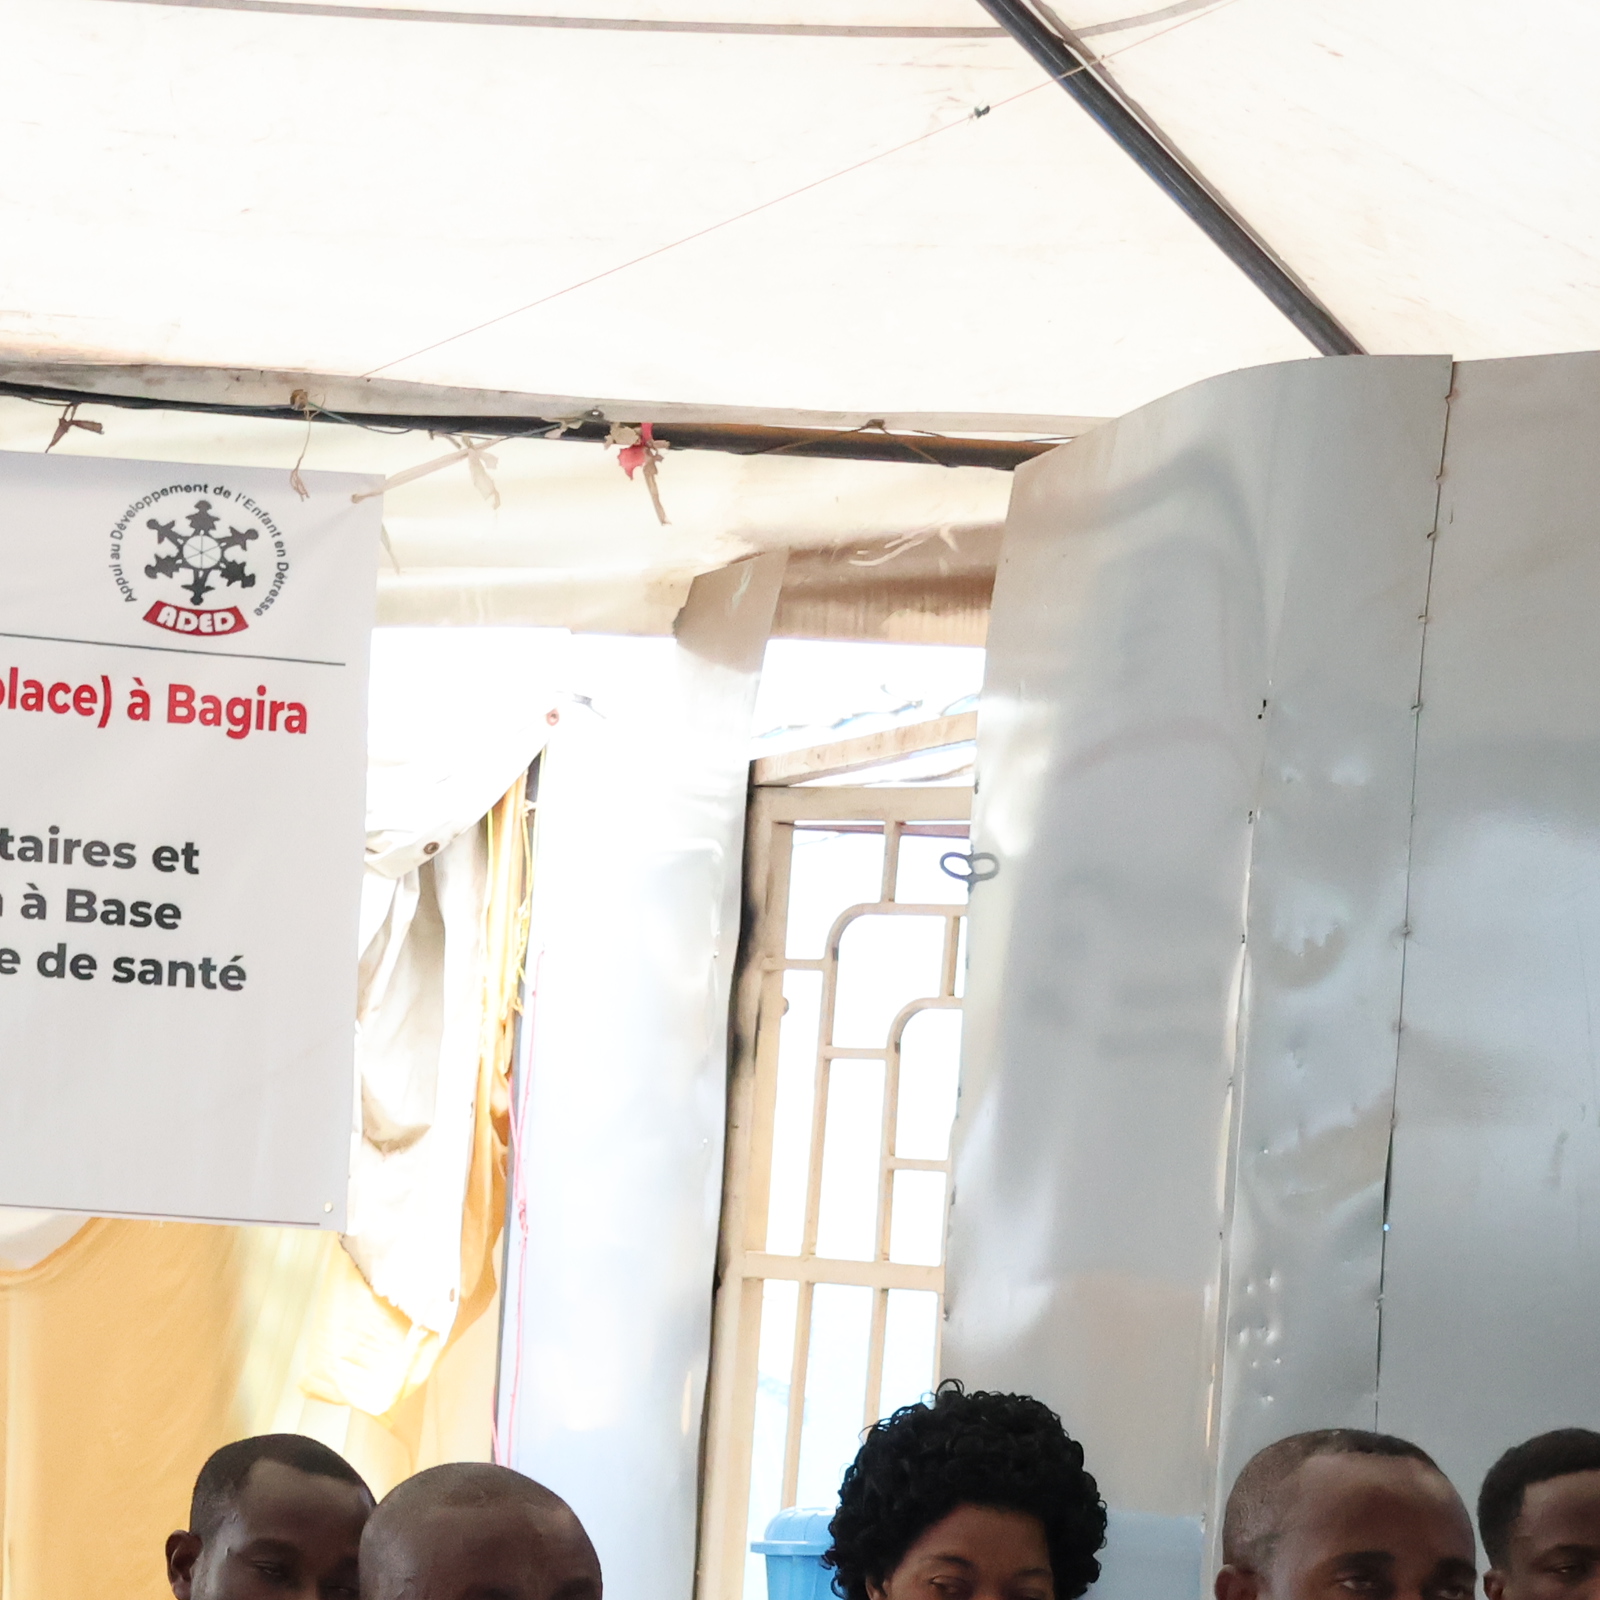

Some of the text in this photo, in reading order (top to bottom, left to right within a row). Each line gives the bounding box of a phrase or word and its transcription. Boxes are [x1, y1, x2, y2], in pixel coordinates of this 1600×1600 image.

[213, 485, 232, 500] de
[110, 483, 209, 541] Développement
[109, 544, 121, 561] au
[274, 540, 287, 559] en
[109, 564, 138, 603] Appui
[156, 605, 236, 634] ADED
[126, 677, 151, 721] à
[166, 683, 308, 740] Bagira
[152, 841, 201, 875] et
[20, 882, 48, 920] à
[65, 888, 182, 930] Base
[36, 942, 98, 981] de
[111, 954, 247, 992] santé
